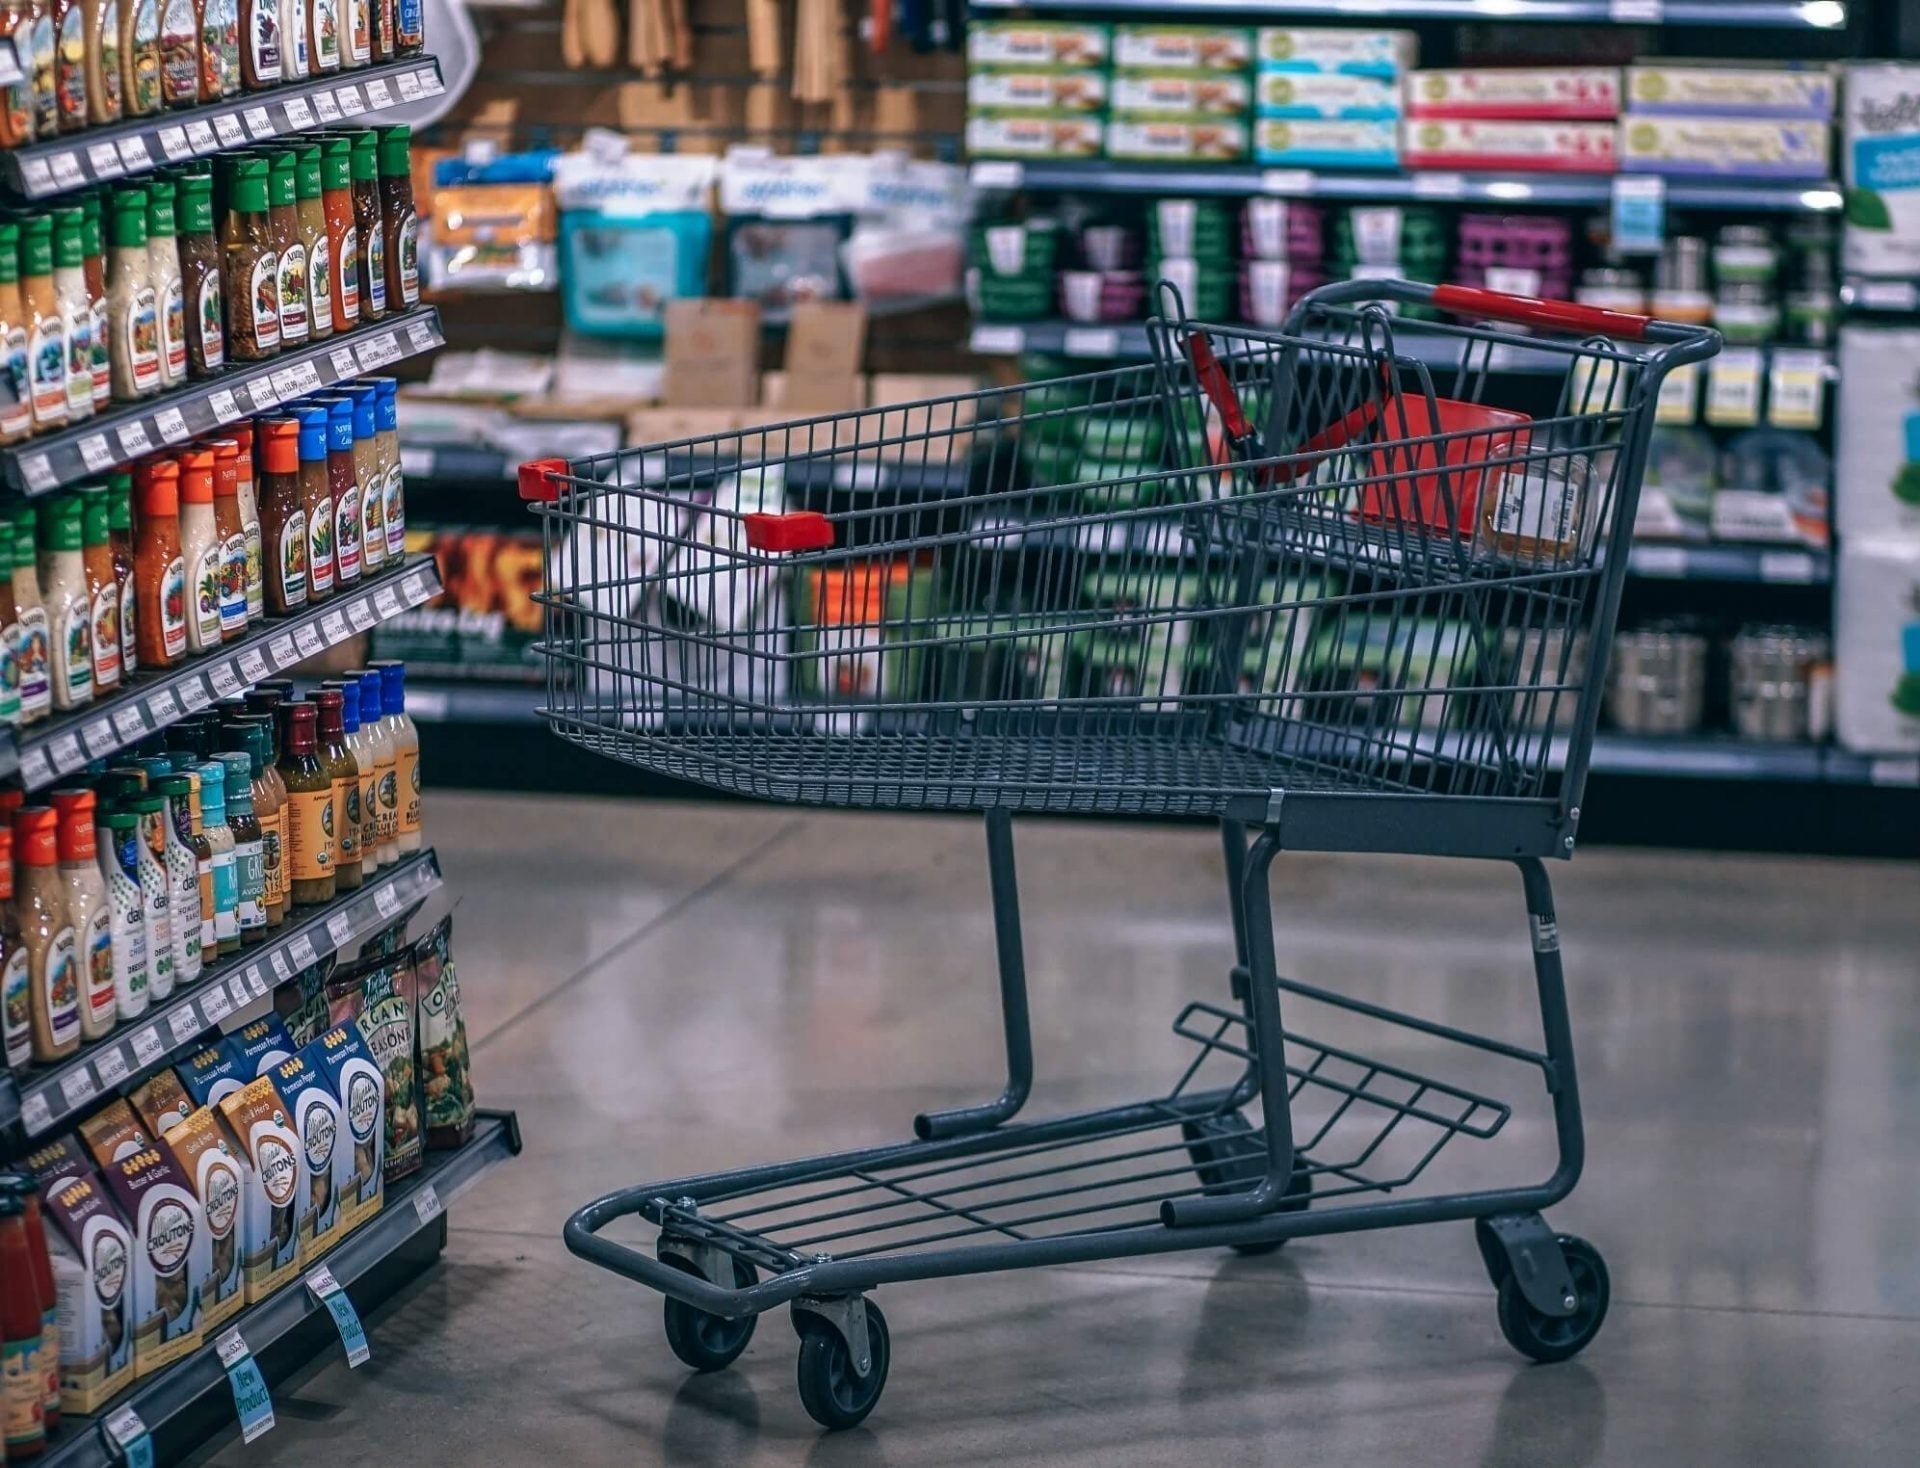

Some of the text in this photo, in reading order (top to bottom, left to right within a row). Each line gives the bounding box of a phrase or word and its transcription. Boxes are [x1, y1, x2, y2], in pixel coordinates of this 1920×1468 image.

[261, 1153, 297, 1184] CRUTONS
[205, 1182, 238, 1216] CROUTONS
[146, 1219, 194, 1252] CROUTONS
[235, 1369, 255, 1389] New
[236, 1386, 269, 1416] Product
